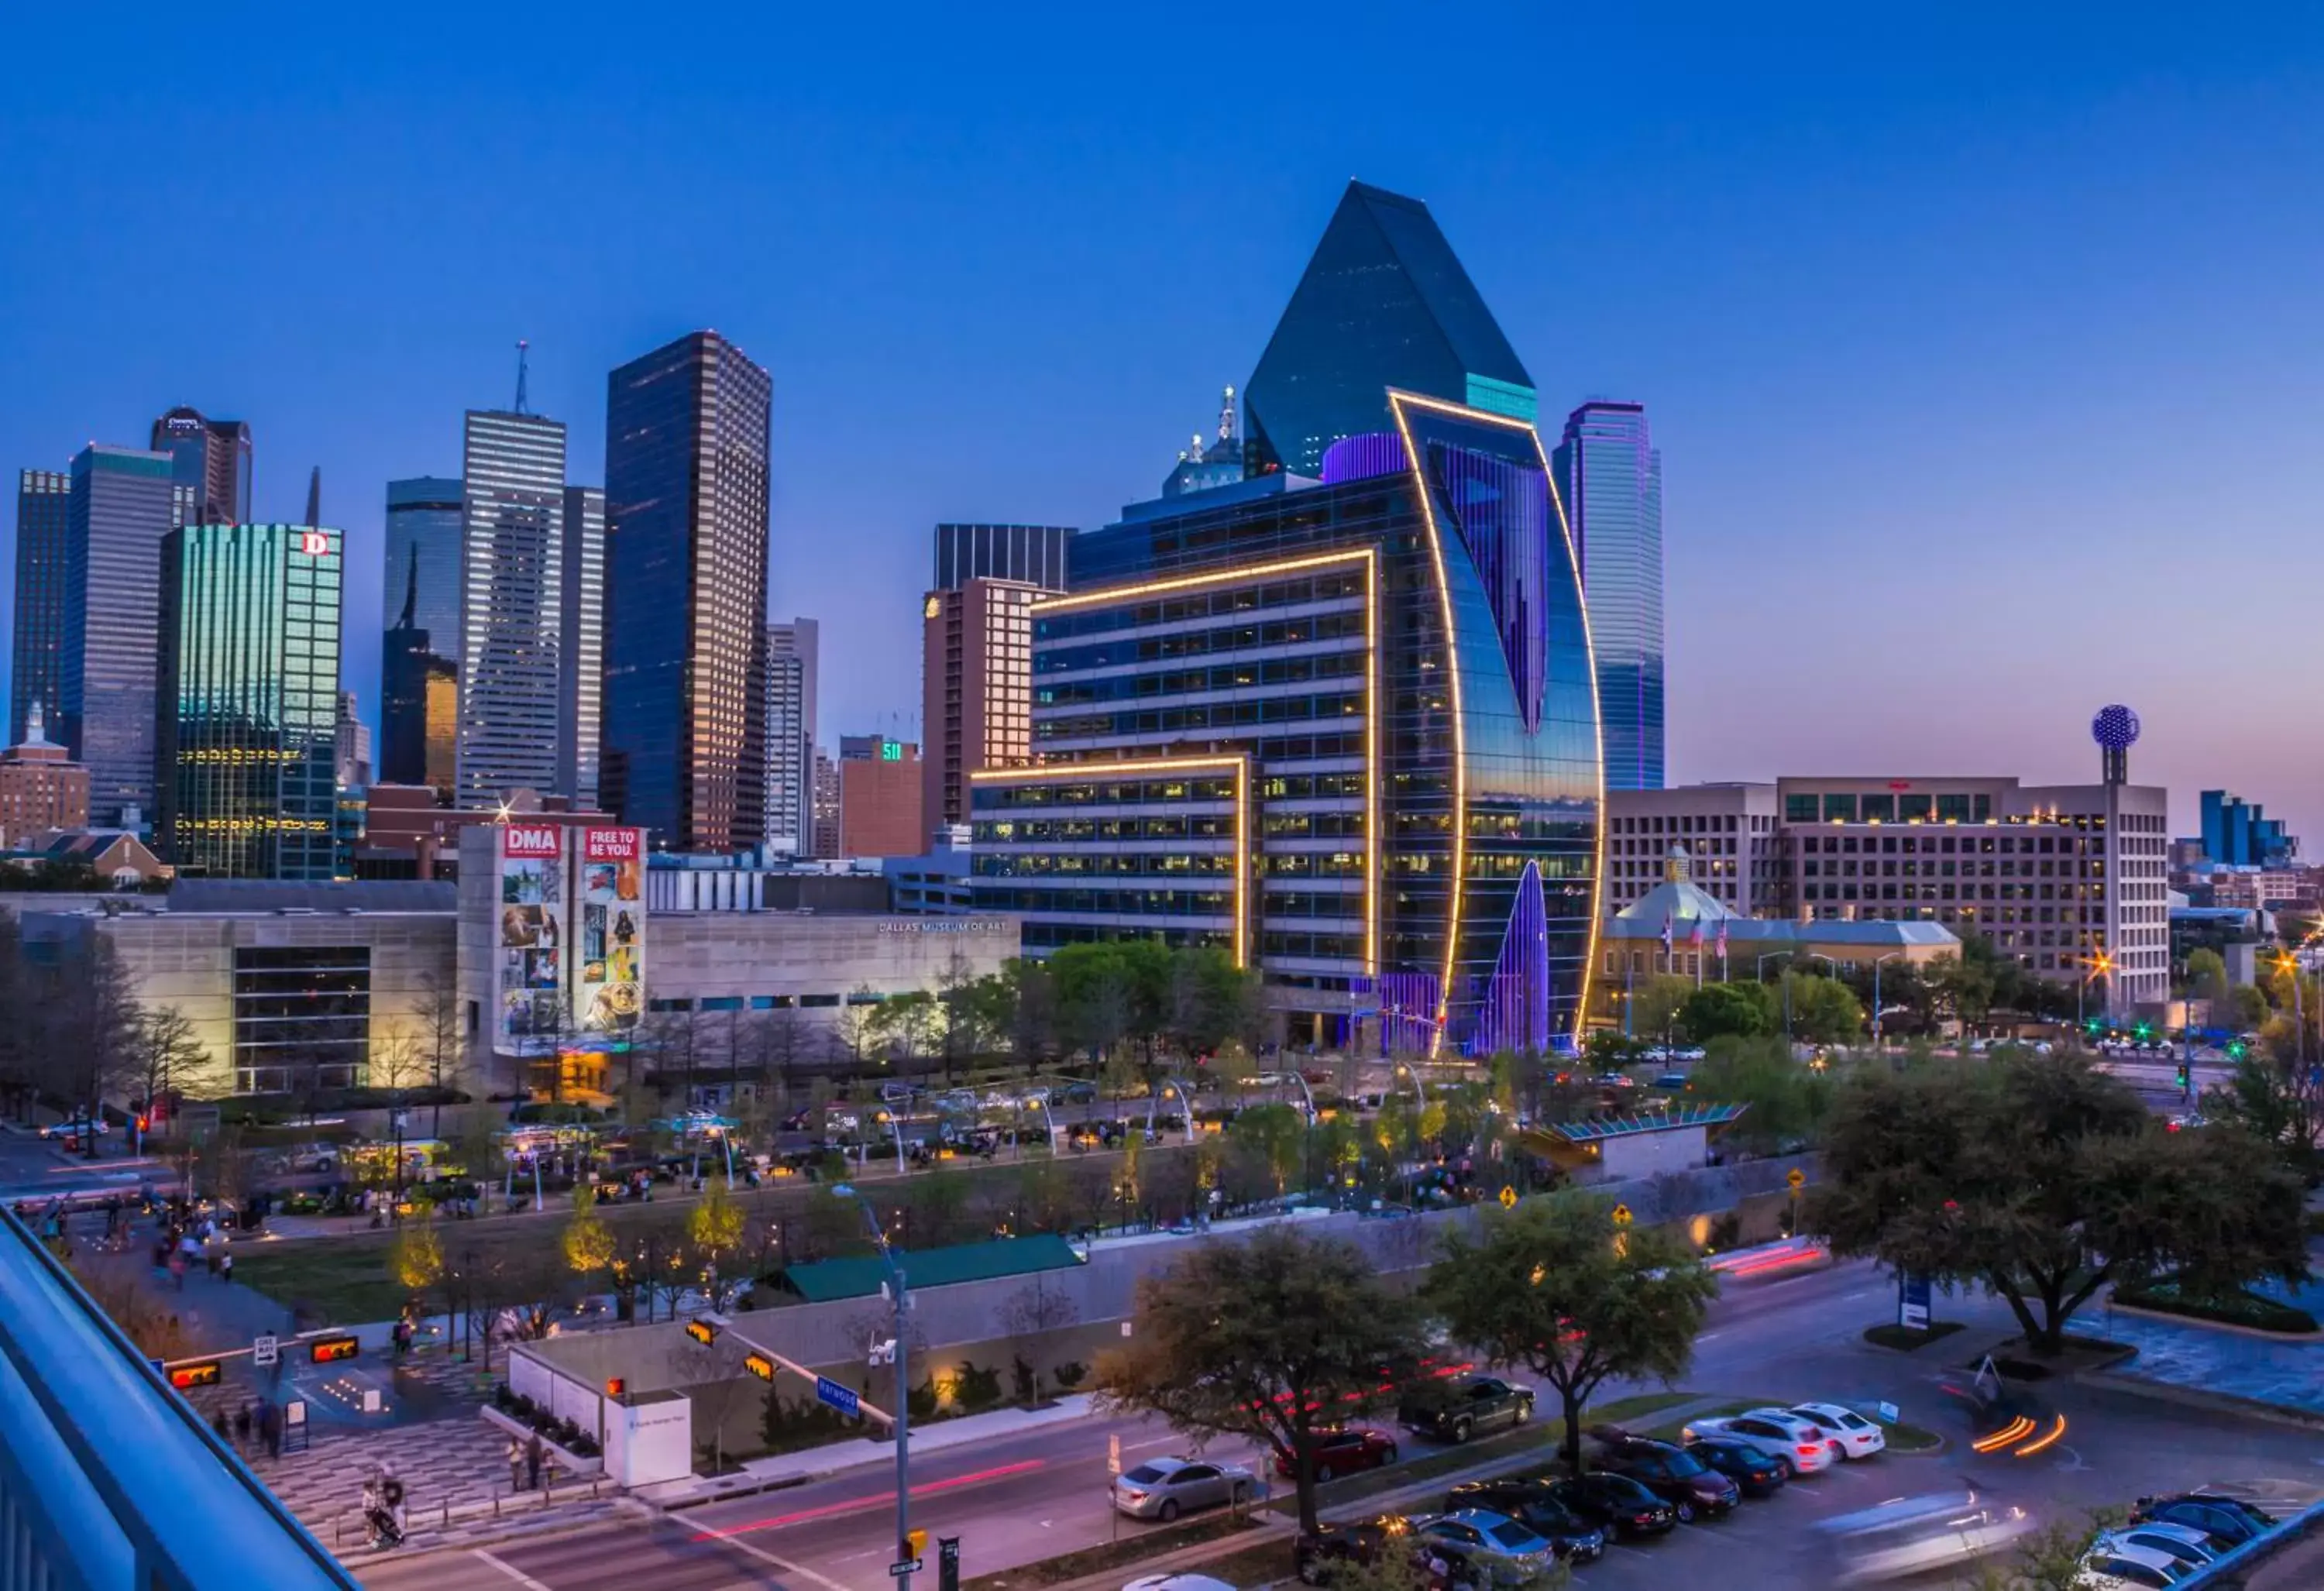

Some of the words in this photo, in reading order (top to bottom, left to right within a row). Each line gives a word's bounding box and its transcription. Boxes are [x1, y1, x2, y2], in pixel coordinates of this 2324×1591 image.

[307, 534, 326, 553] D
[509, 830, 555, 849] DMA
[590, 831, 617, 844] FREE
[619, 831, 634, 844] TO
[590, 844, 604, 856] BE
[607, 844, 633, 856] YOU.
[879, 923, 918, 932] DALLAS
[922, 923, 968, 932] MUSEUM
[971, 922, 983, 931] OF
[986, 922, 1006, 930] ART
